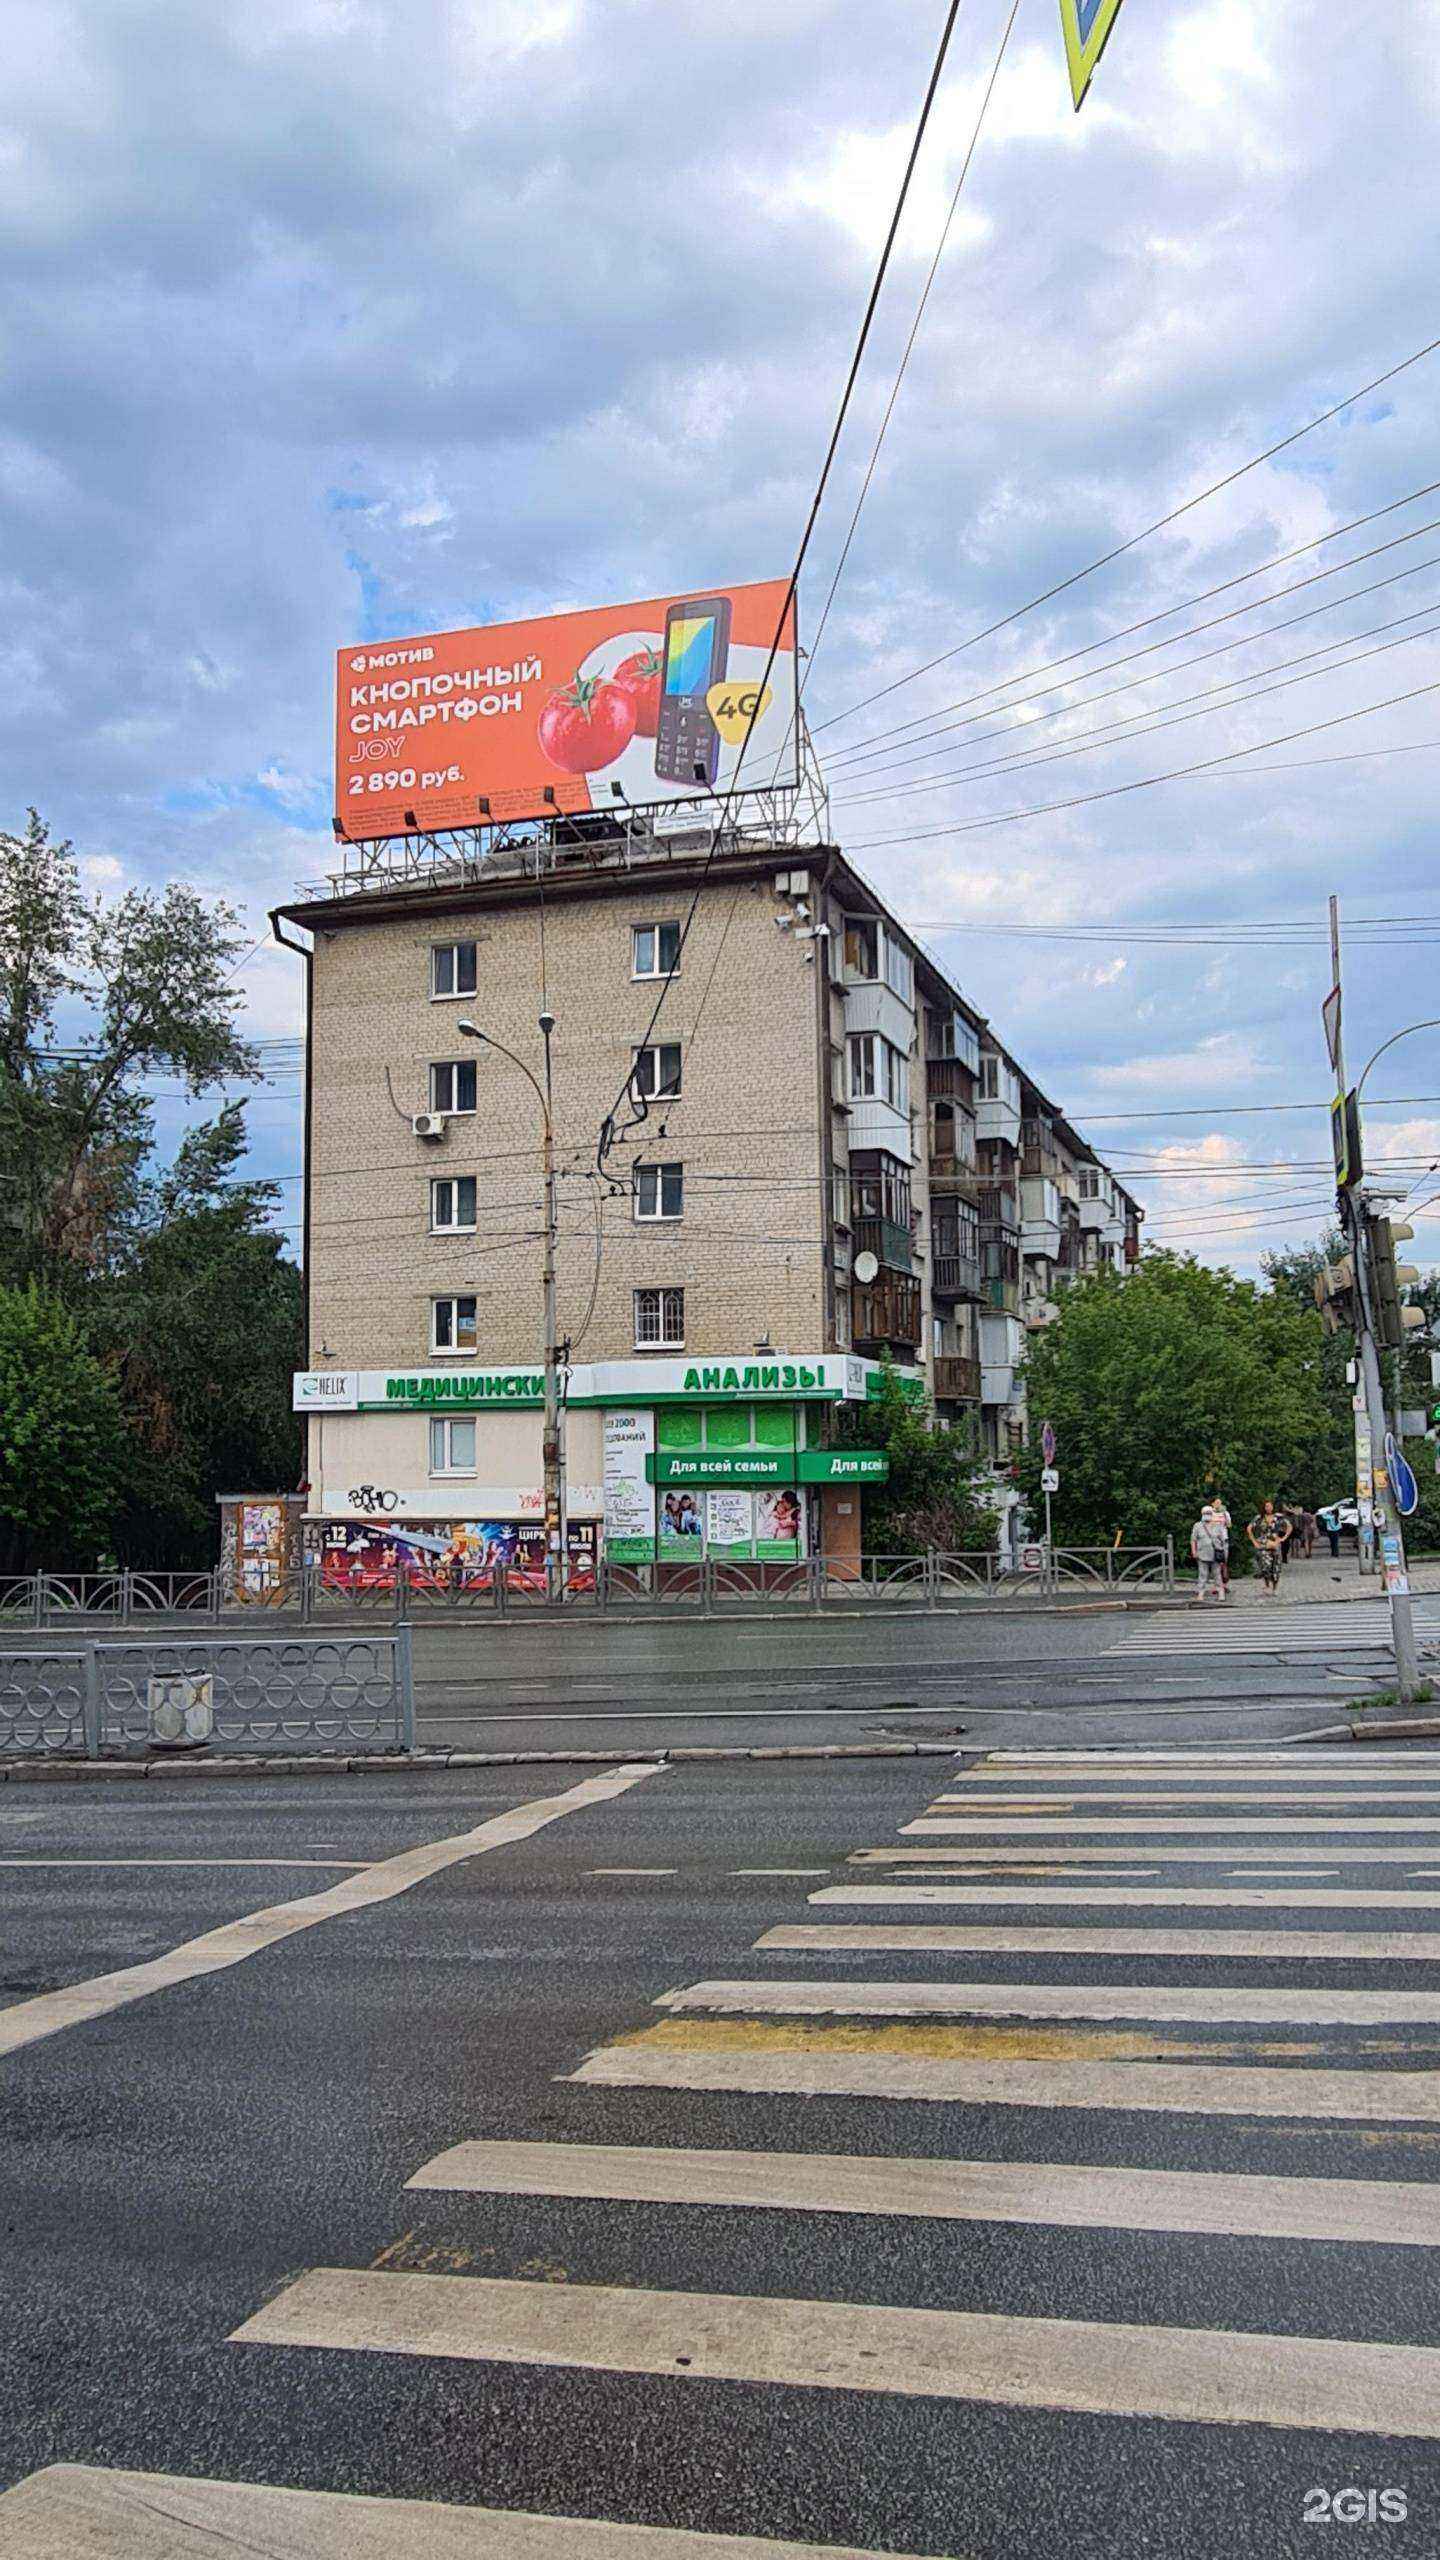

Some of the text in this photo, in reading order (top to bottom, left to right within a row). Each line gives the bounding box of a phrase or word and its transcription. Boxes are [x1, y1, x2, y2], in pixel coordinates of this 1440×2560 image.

[368, 647, 435, 670] МОТИВ
[350, 654, 542, 707] КНОПОЧНЫЙ
[350, 691, 522, 734] СМАРТФОН
[716, 693, 762, 719] 4G
[349, 736, 406, 763] JOY
[421, 764, 465, 789] руб.
[319, 1376, 348, 1395] HELIX
[684, 1365, 825, 1390] АНАЛИЗЫ
[669, 1460, 778, 1475] Для всей семьи
[830, 1459, 858, 1474] Для
[331, 1526, 347, 1540] 12
